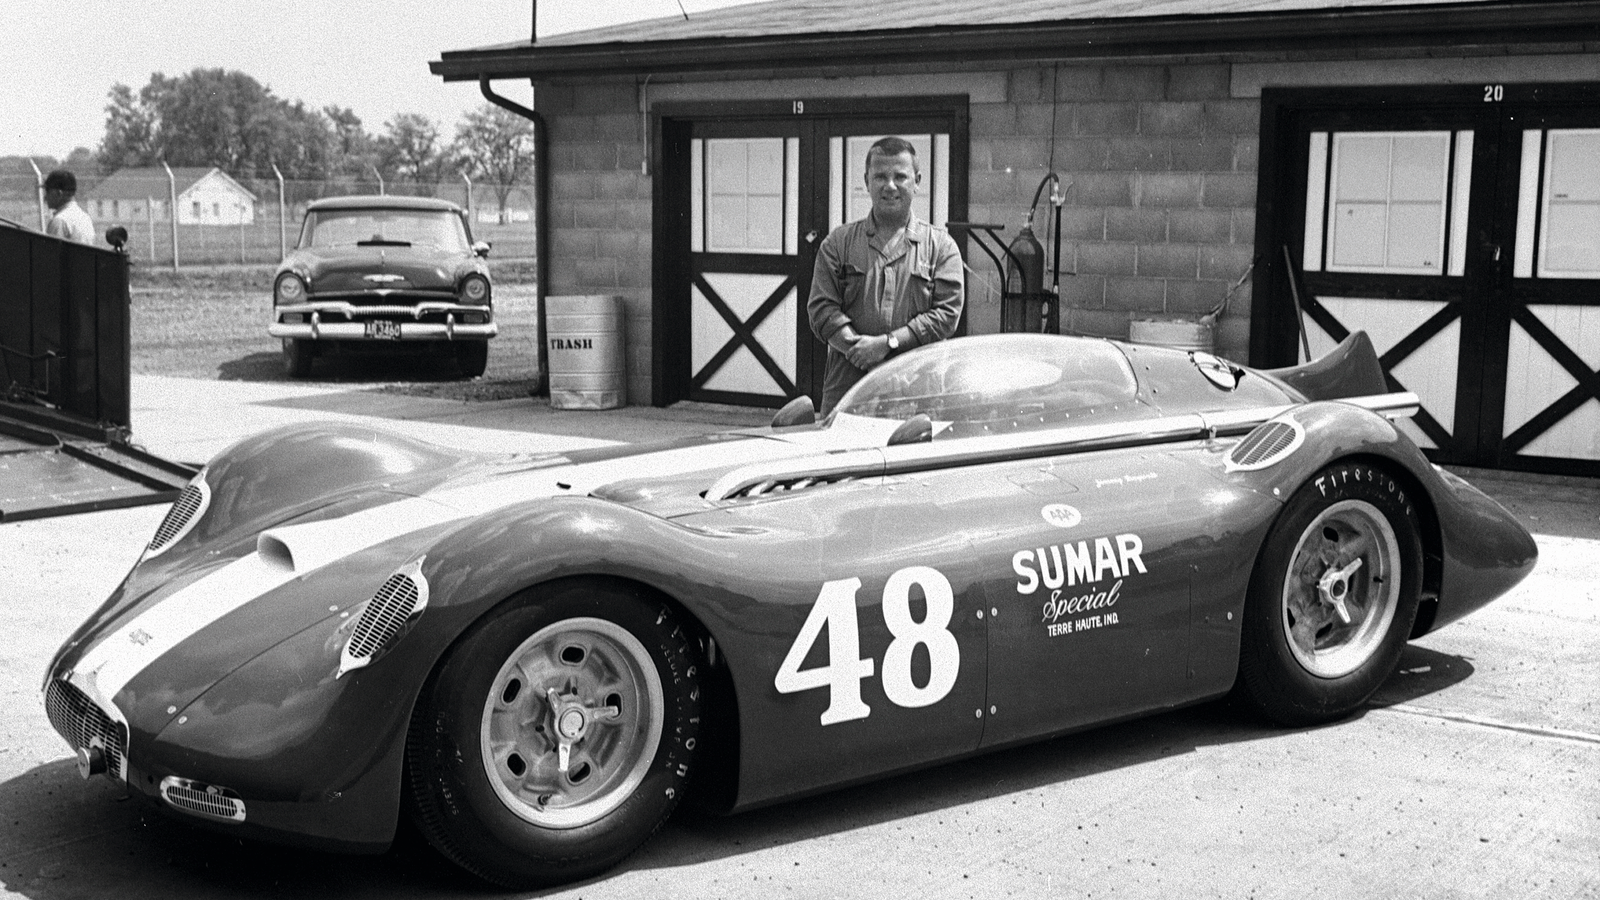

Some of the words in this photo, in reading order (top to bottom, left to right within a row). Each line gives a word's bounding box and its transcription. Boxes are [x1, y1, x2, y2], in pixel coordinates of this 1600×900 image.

[1484, 84, 1503, 102] 20
[793, 100, 804, 114] 19
[550, 339, 593, 350] TRASH
[1050, 509, 1074, 521] AAA
[1012, 533, 1148, 594] SUMAR
[1042, 579, 1123, 622] Special
[1047, 622, 1073, 637] TERRE
[774, 566, 960, 726] 48
